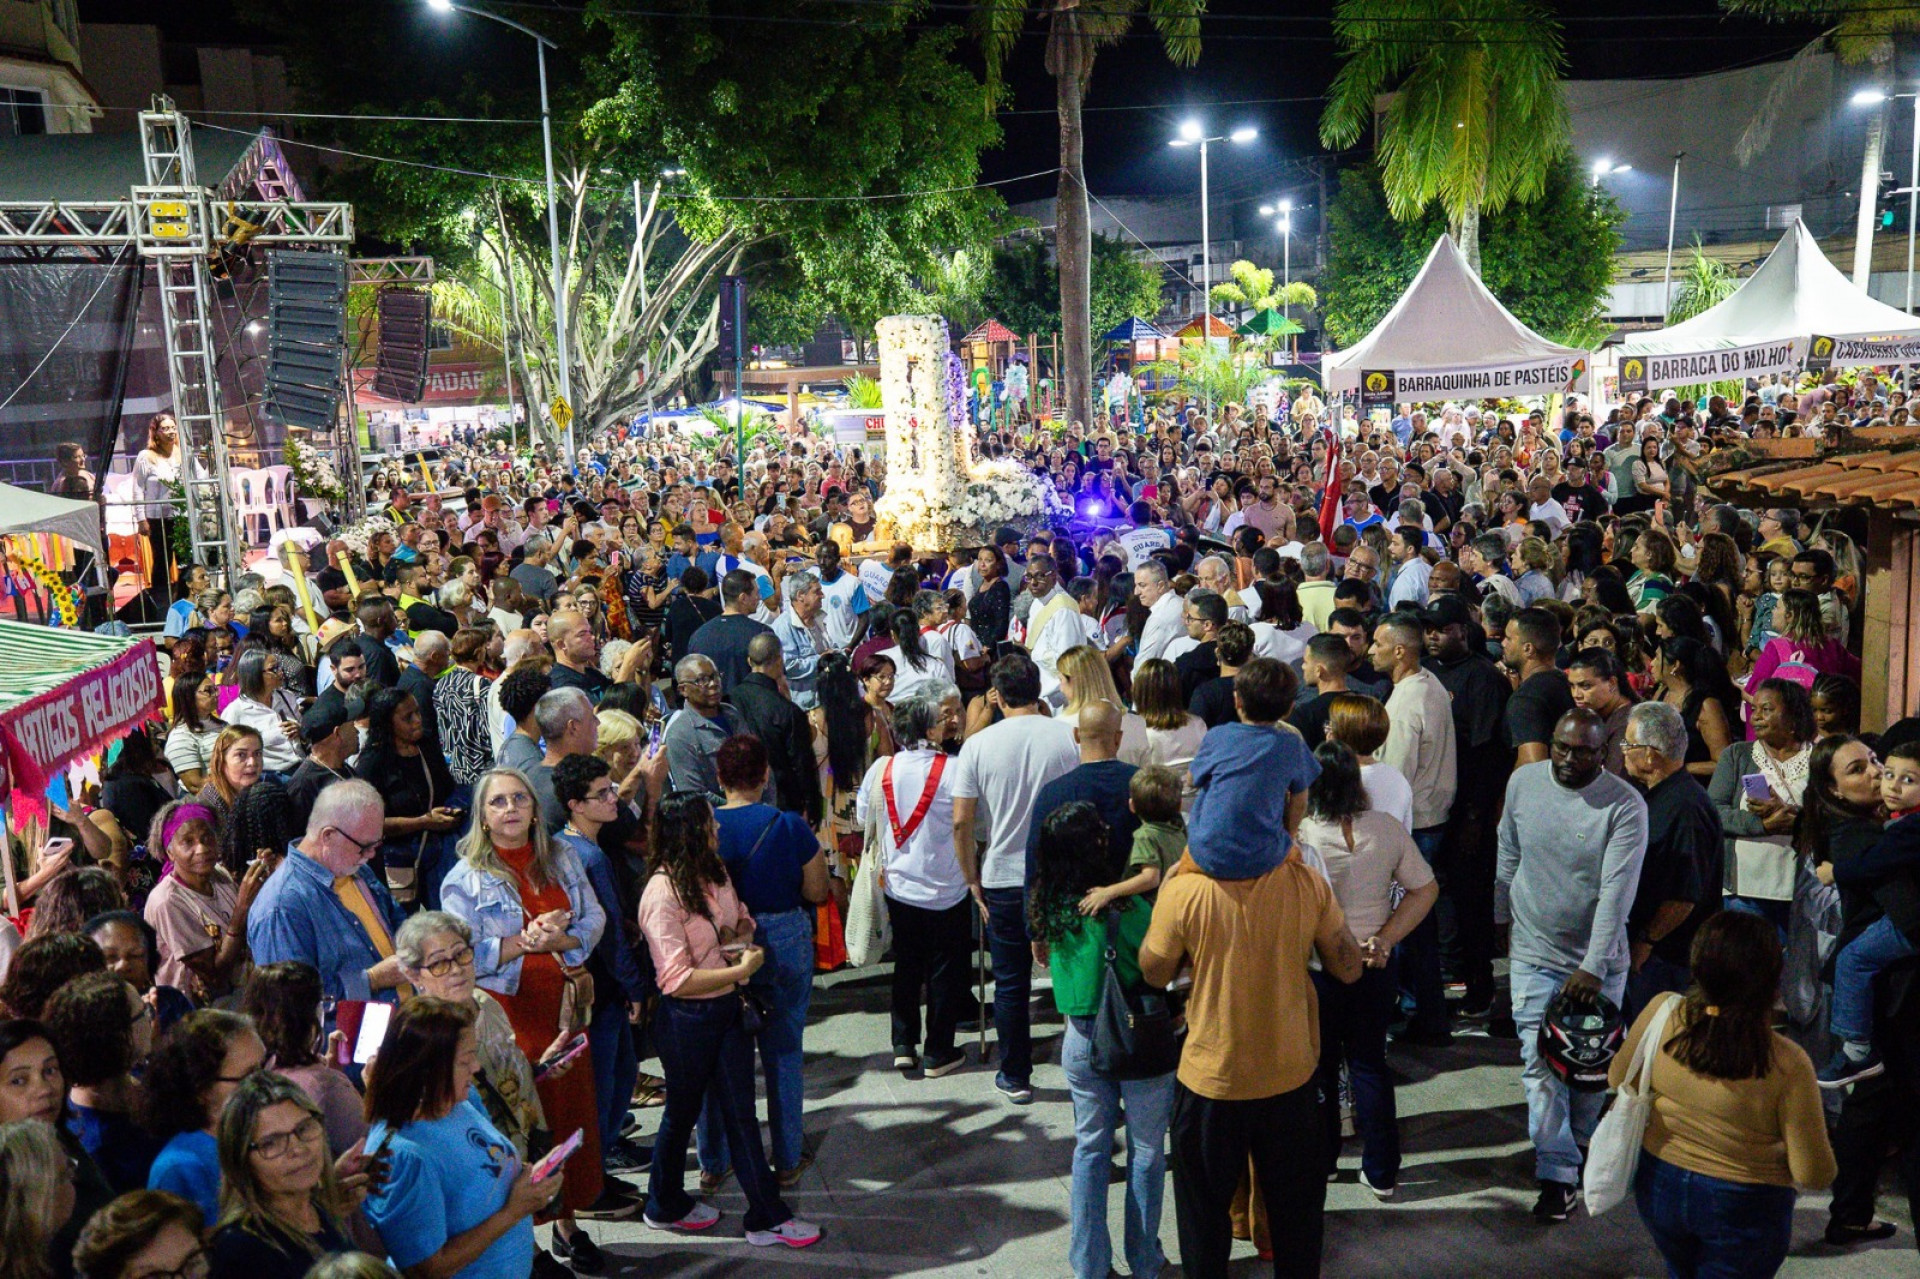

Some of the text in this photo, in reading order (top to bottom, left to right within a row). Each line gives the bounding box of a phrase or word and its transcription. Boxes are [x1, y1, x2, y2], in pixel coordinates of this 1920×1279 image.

[1399, 363, 1568, 393] BARRAQUINHA DE PASTÉIS
[1652, 346, 1787, 381] BARRACA DO MILHO
[864, 570, 889, 588] GUARD
[14, 652, 158, 767] ARTIGOS RELIGIOSOS
